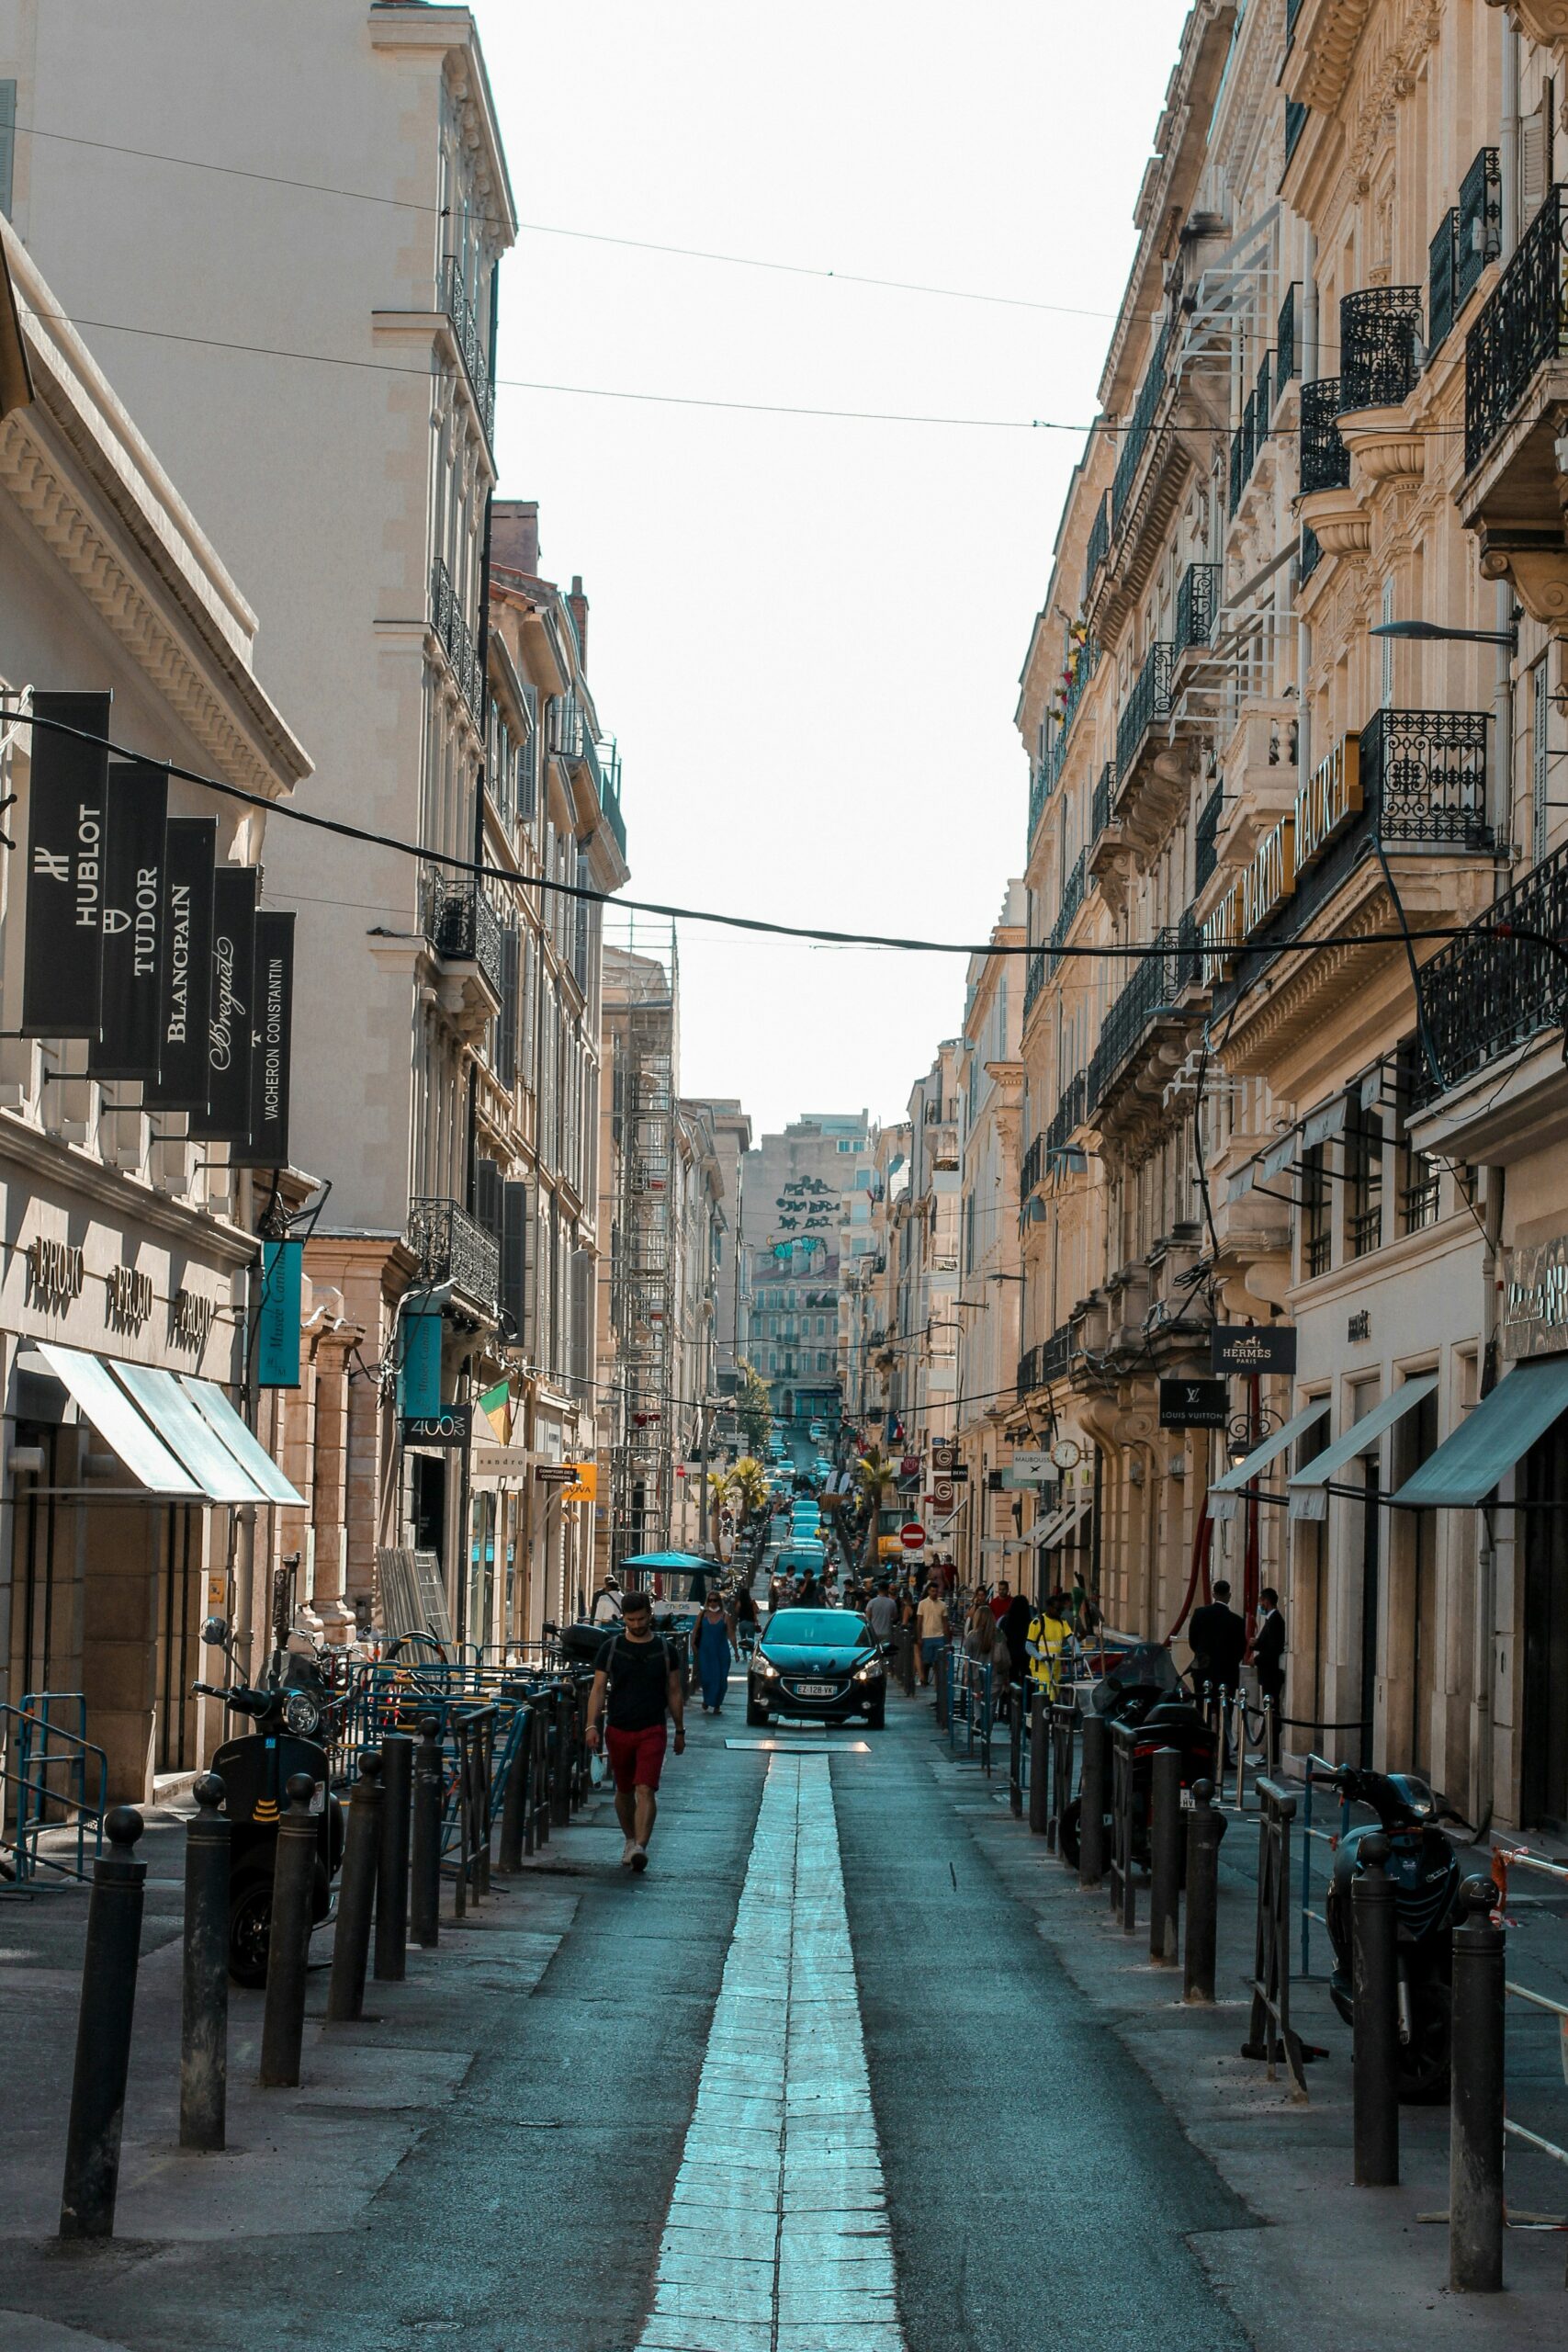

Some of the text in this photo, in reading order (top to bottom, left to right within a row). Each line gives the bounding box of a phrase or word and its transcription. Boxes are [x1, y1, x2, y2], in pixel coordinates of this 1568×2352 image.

[75, 803, 102, 927] HUBLOT
[133, 865, 158, 977] TUDOR
[167, 883, 191, 1044] BLANCPAIN
[209, 936, 245, 1071] Breguet
[264, 958, 284, 1121] VACHERON CONSTANTIN
[270, 1309, 286, 1351] Musée
[479, 1456, 524, 1466] sandro
[1162, 1411, 1224, 1419] LOUIS VUITTON
